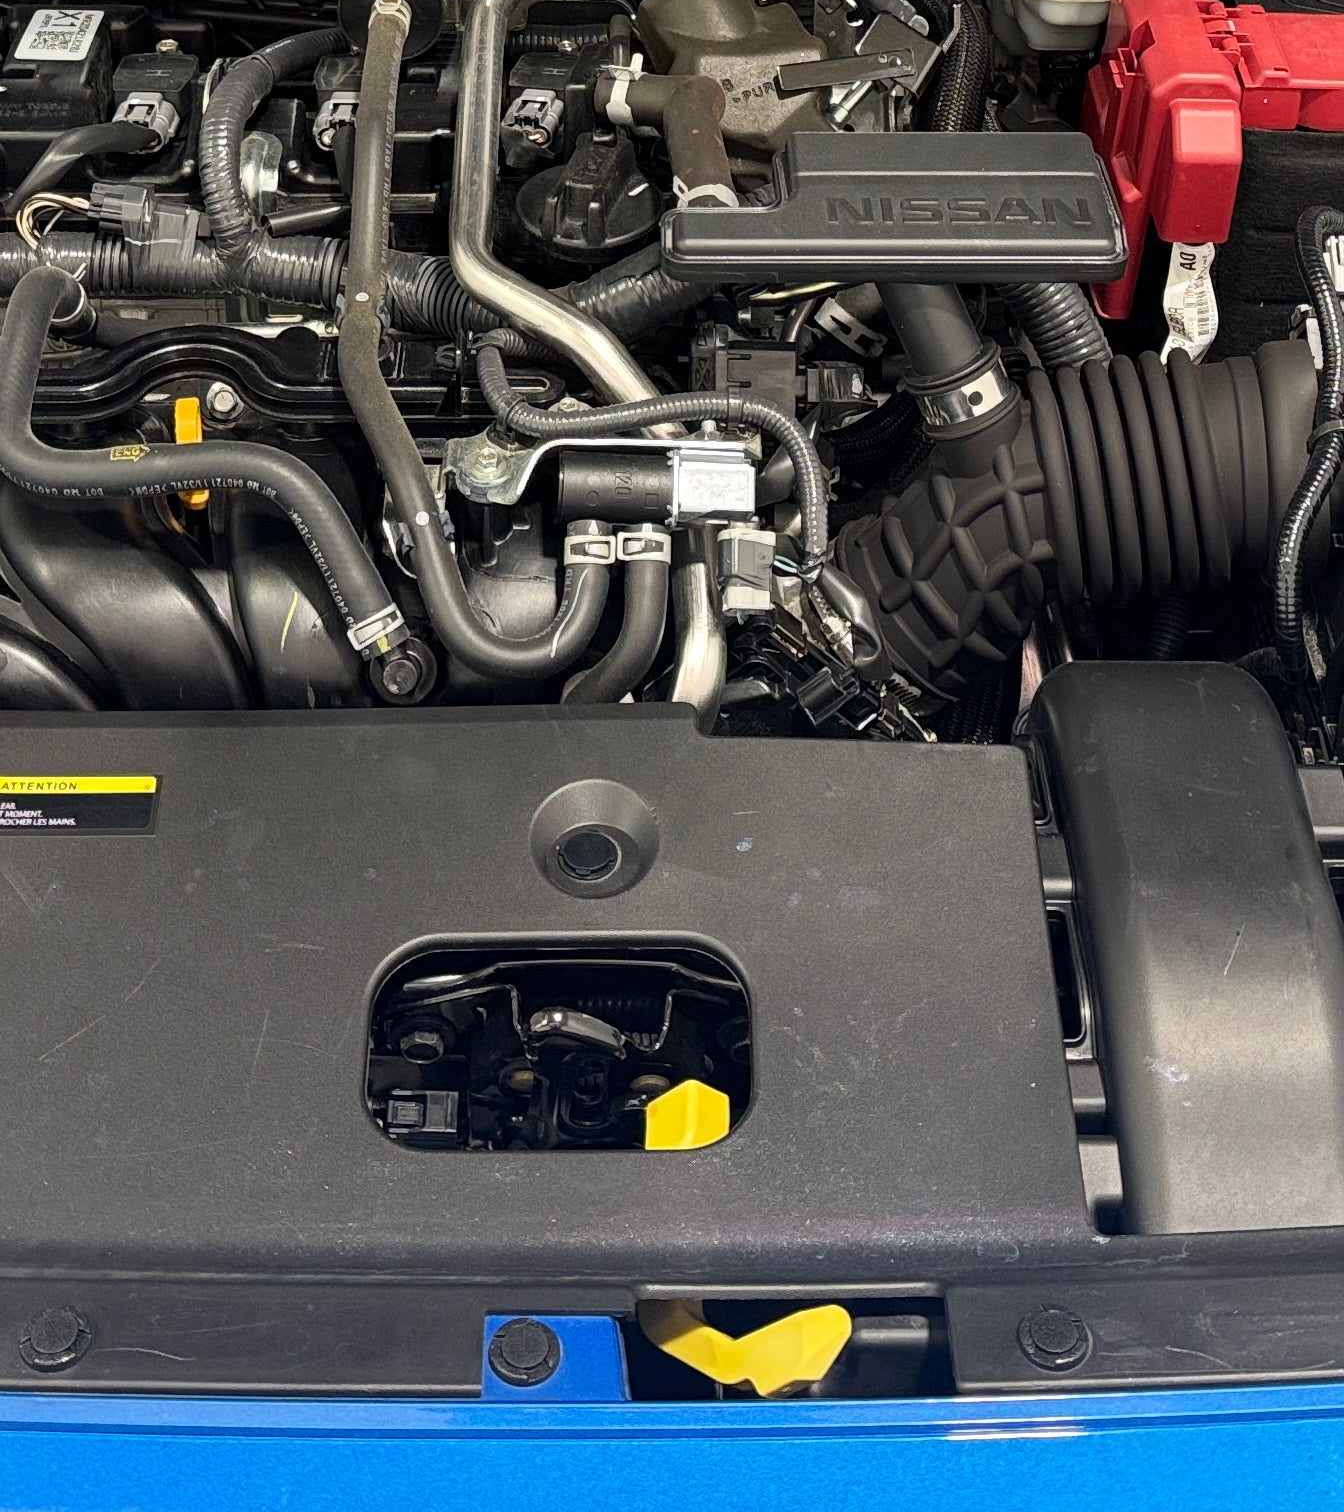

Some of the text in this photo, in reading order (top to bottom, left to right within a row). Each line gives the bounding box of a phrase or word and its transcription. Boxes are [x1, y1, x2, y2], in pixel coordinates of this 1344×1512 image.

[827, 196, 1093, 225] NISSAN
[614, 470, 632, 499] 120
[1, 781, 78, 791] ATTENTION
[4, 810, 43, 818] MOMENT.
[33, 818, 47, 826] LES
[48, 818, 77, 826] MAINS.
